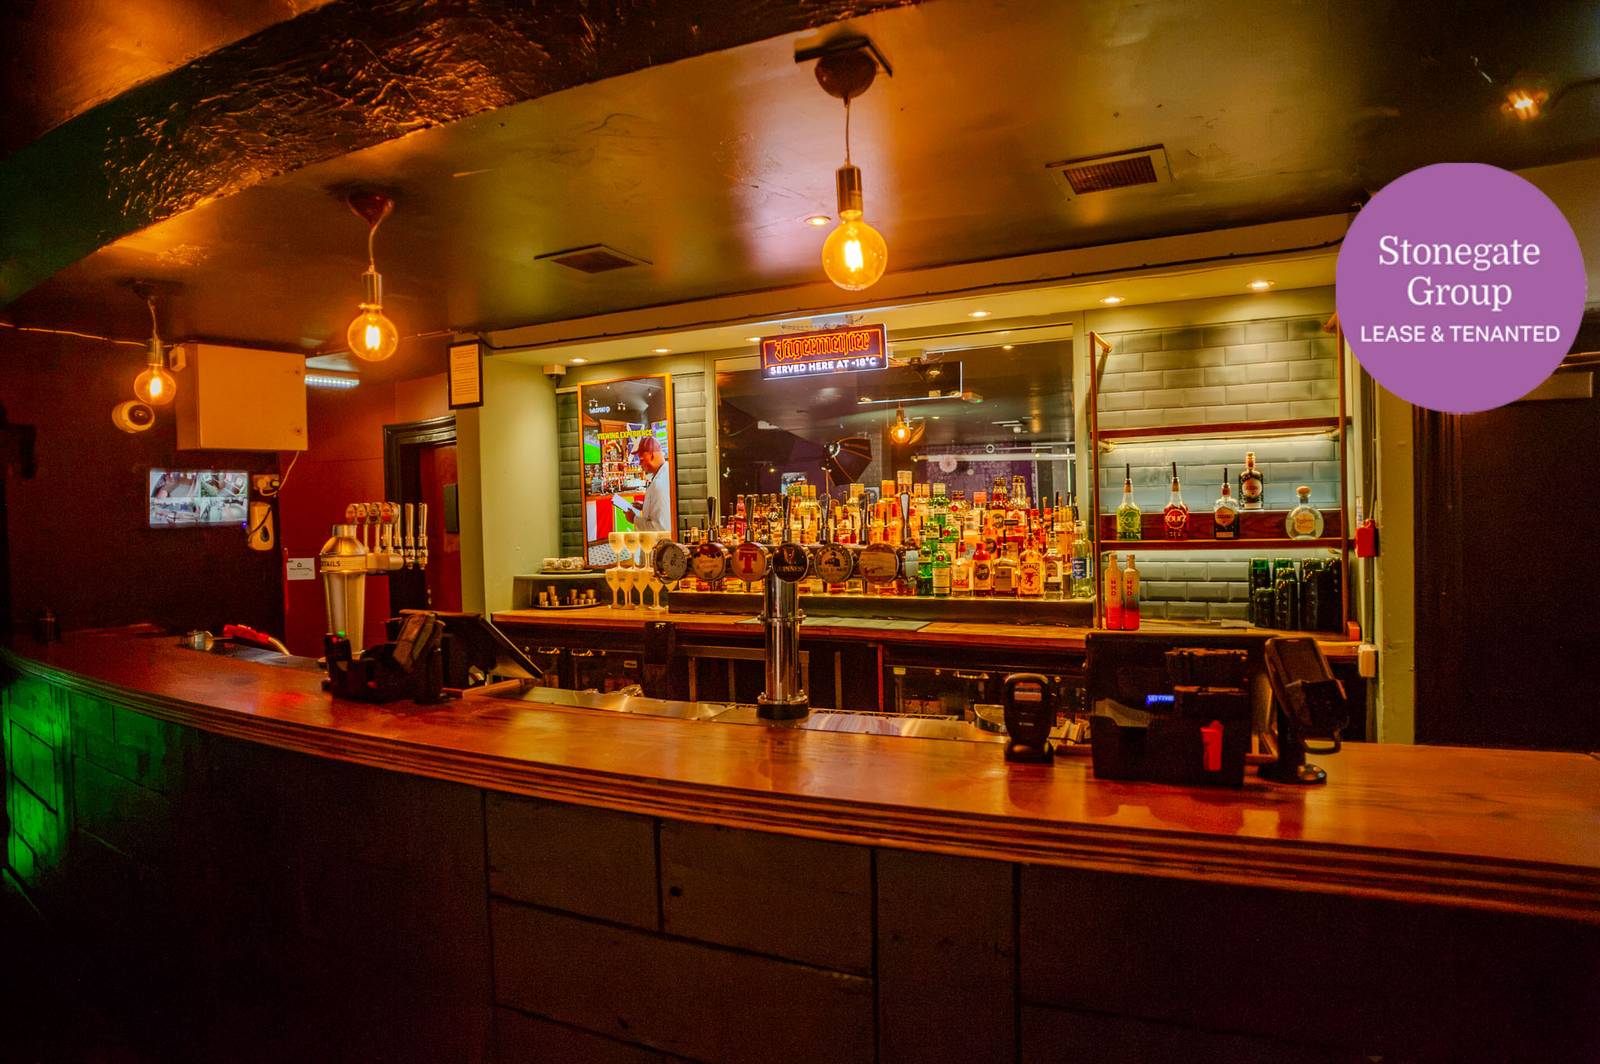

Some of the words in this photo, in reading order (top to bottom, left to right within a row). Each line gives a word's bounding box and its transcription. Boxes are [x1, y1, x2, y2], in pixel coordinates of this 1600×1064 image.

[770, 362, 806, 376] SERVED
[808, 361, 834, 372] HERE
[837, 359, 850, 369] AT
